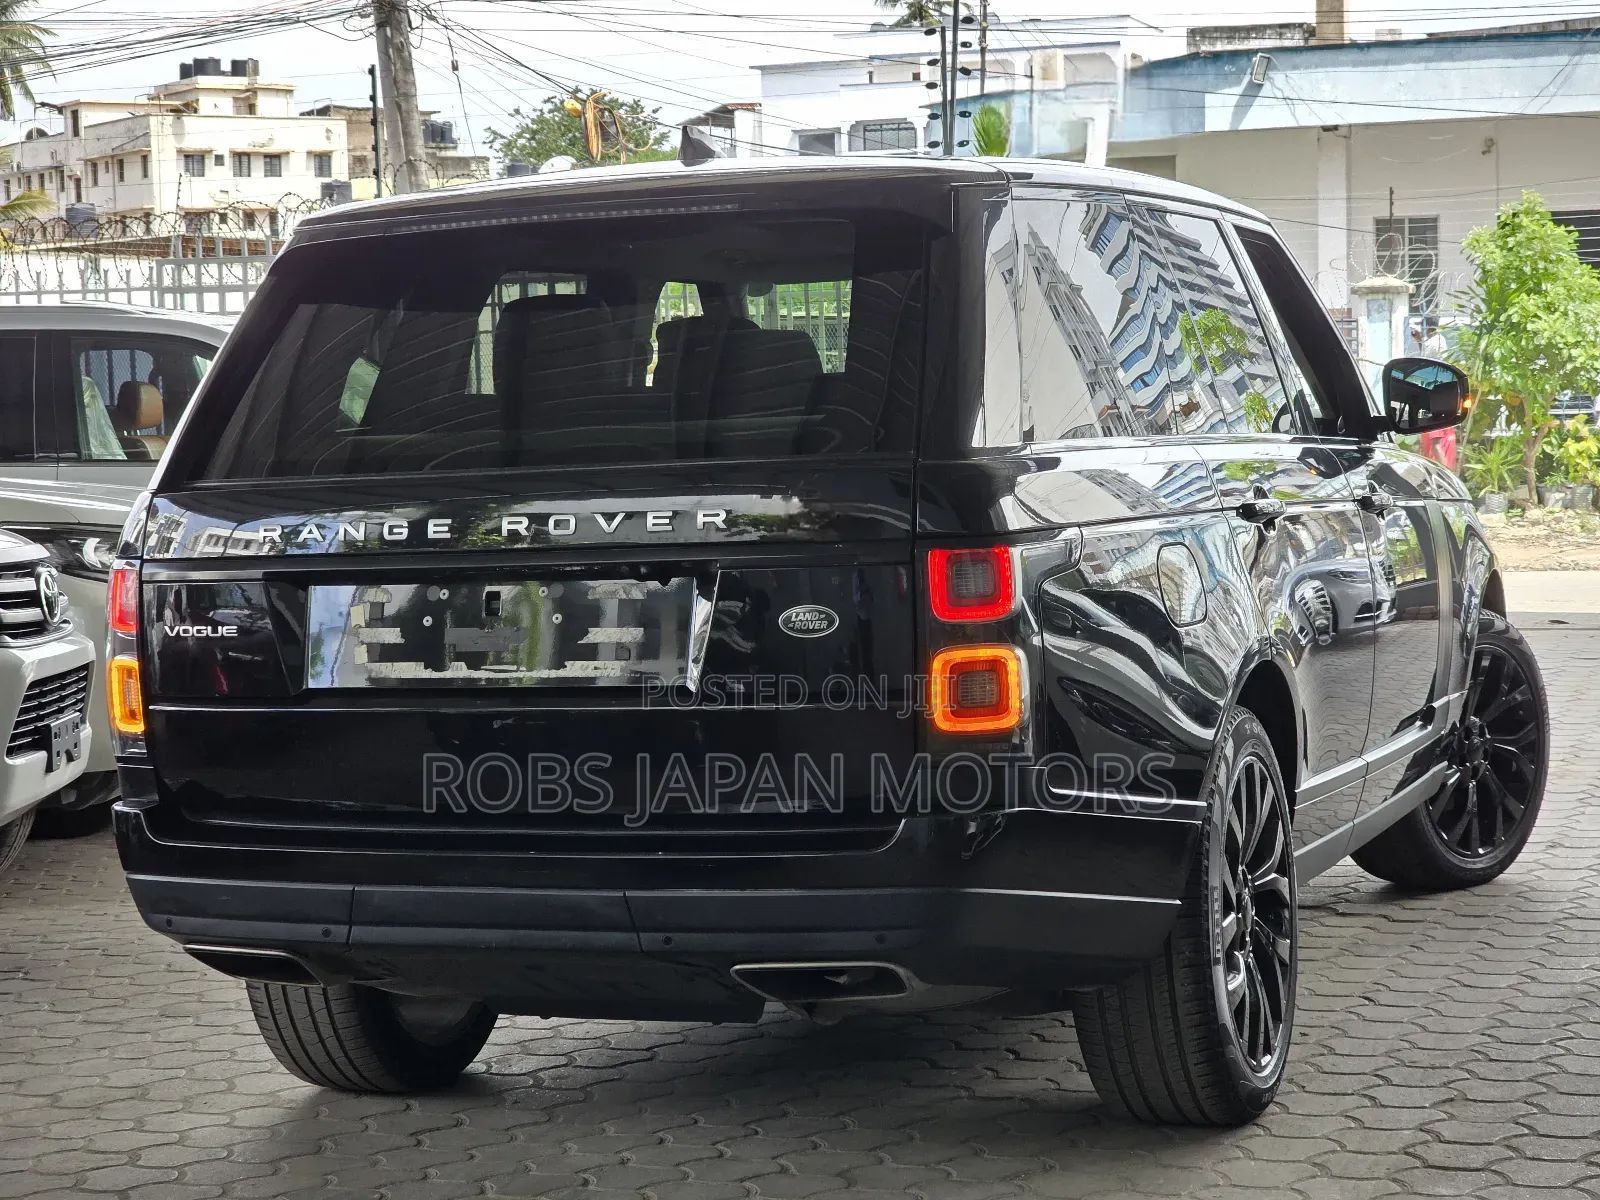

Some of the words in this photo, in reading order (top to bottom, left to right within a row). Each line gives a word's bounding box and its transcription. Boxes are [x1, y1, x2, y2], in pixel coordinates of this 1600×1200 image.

[258, 518, 452, 543] RANGE
[500, 508, 728, 538] ROVER
[790, 611, 819, 621] LAND
[794, 620, 828, 630] ROVER
[164, 625, 238, 637] VOGUE
